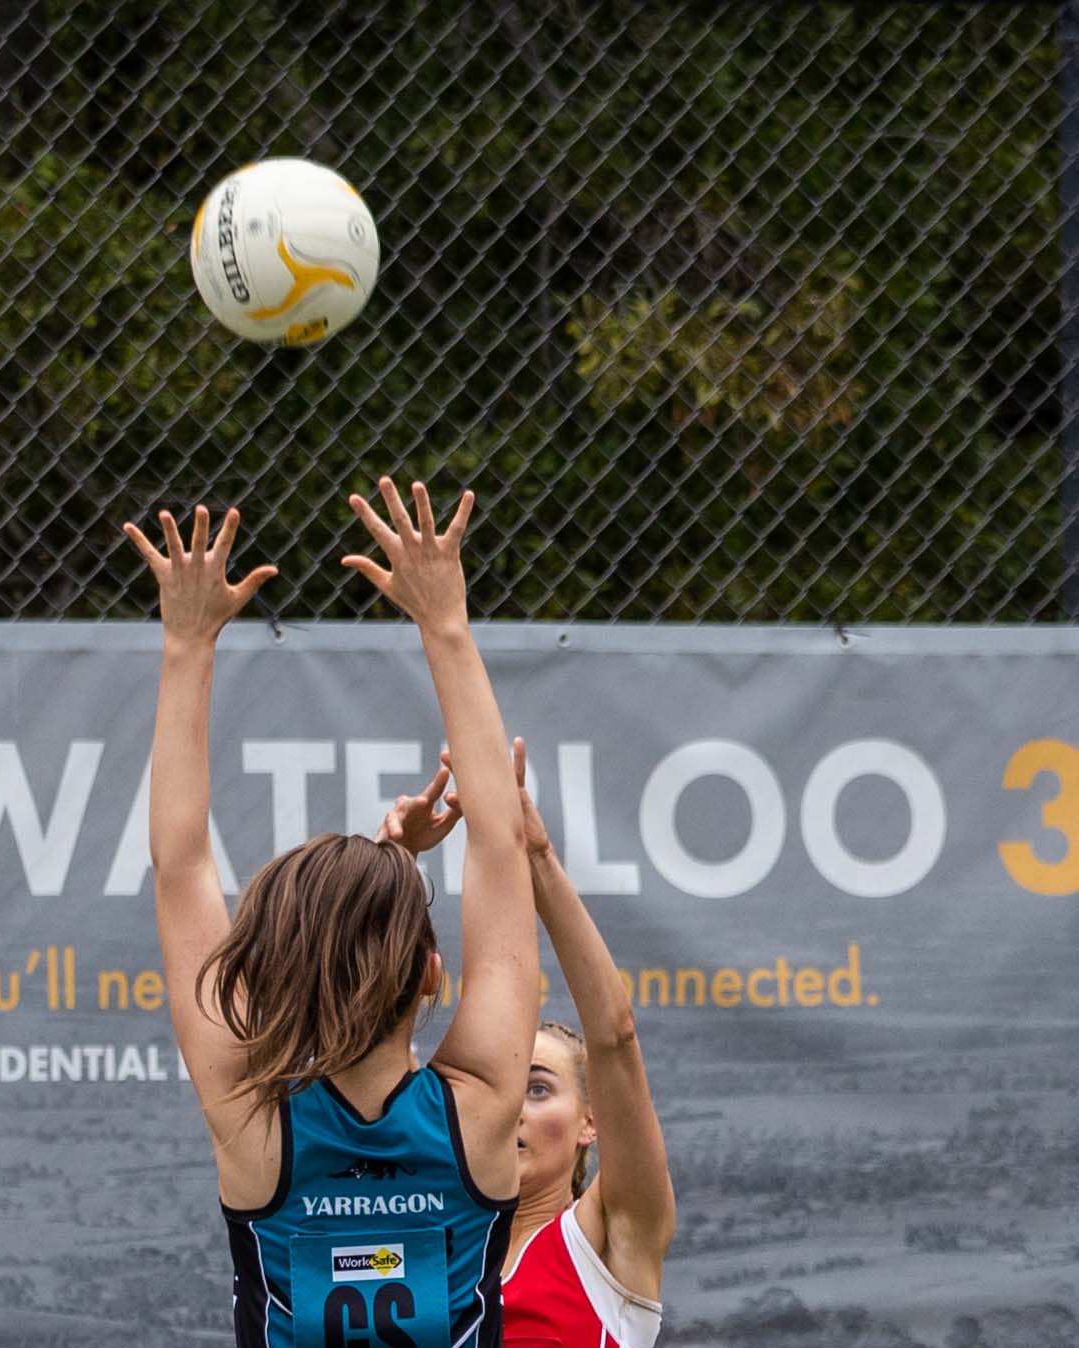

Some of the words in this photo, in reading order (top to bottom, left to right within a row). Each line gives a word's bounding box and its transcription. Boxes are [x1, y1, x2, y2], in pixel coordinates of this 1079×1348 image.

[618, 943, 879, 1008] nnected.
[302, 1193, 444, 1216] YARRAGON
[338, 1253, 397, 1269] WorkSafe
